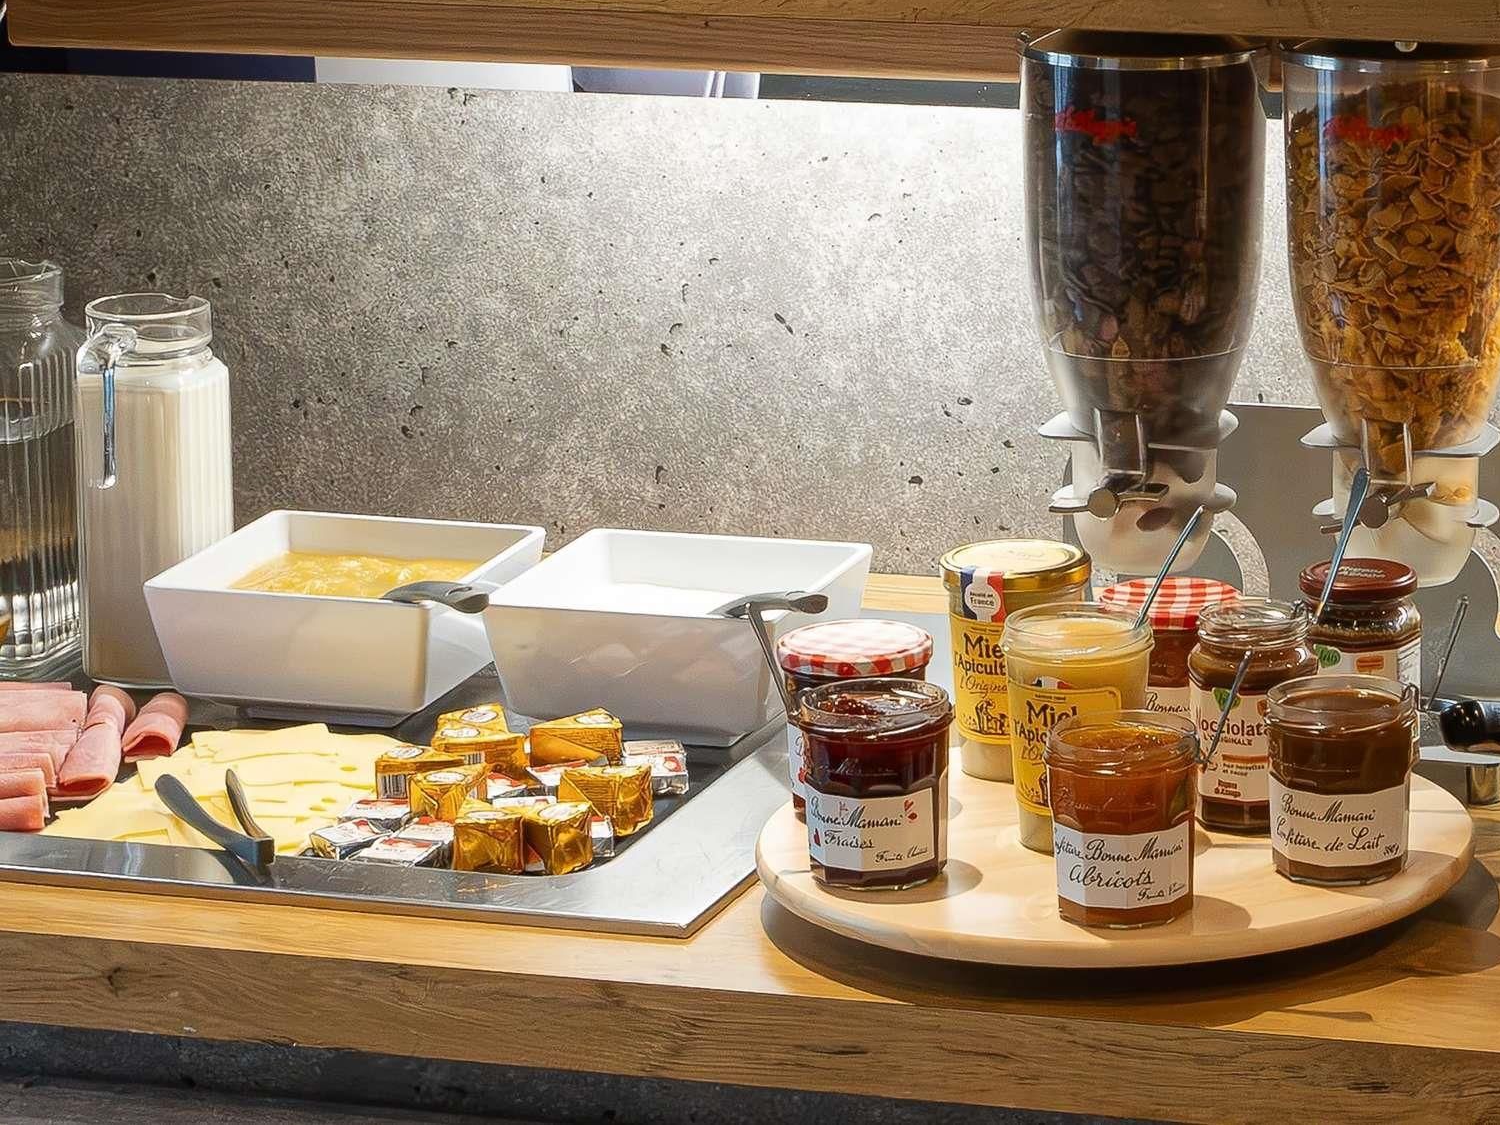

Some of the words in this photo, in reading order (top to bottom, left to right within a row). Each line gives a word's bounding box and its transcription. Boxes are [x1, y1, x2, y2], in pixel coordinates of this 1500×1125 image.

[963, 632, 1005, 660] Mie
[953, 650, 1007, 677] l'Apicult
[1282, 793, 1317, 821] Bonne
[1318, 799, 1376, 823] Maman
[823, 829, 876, 850] Fraises
[1085, 838, 1133, 862] Bonne
[1324, 836, 1345, 852] de
[1347, 826, 1385, 851] Lait
[1069, 864, 1155, 889] Abricots
